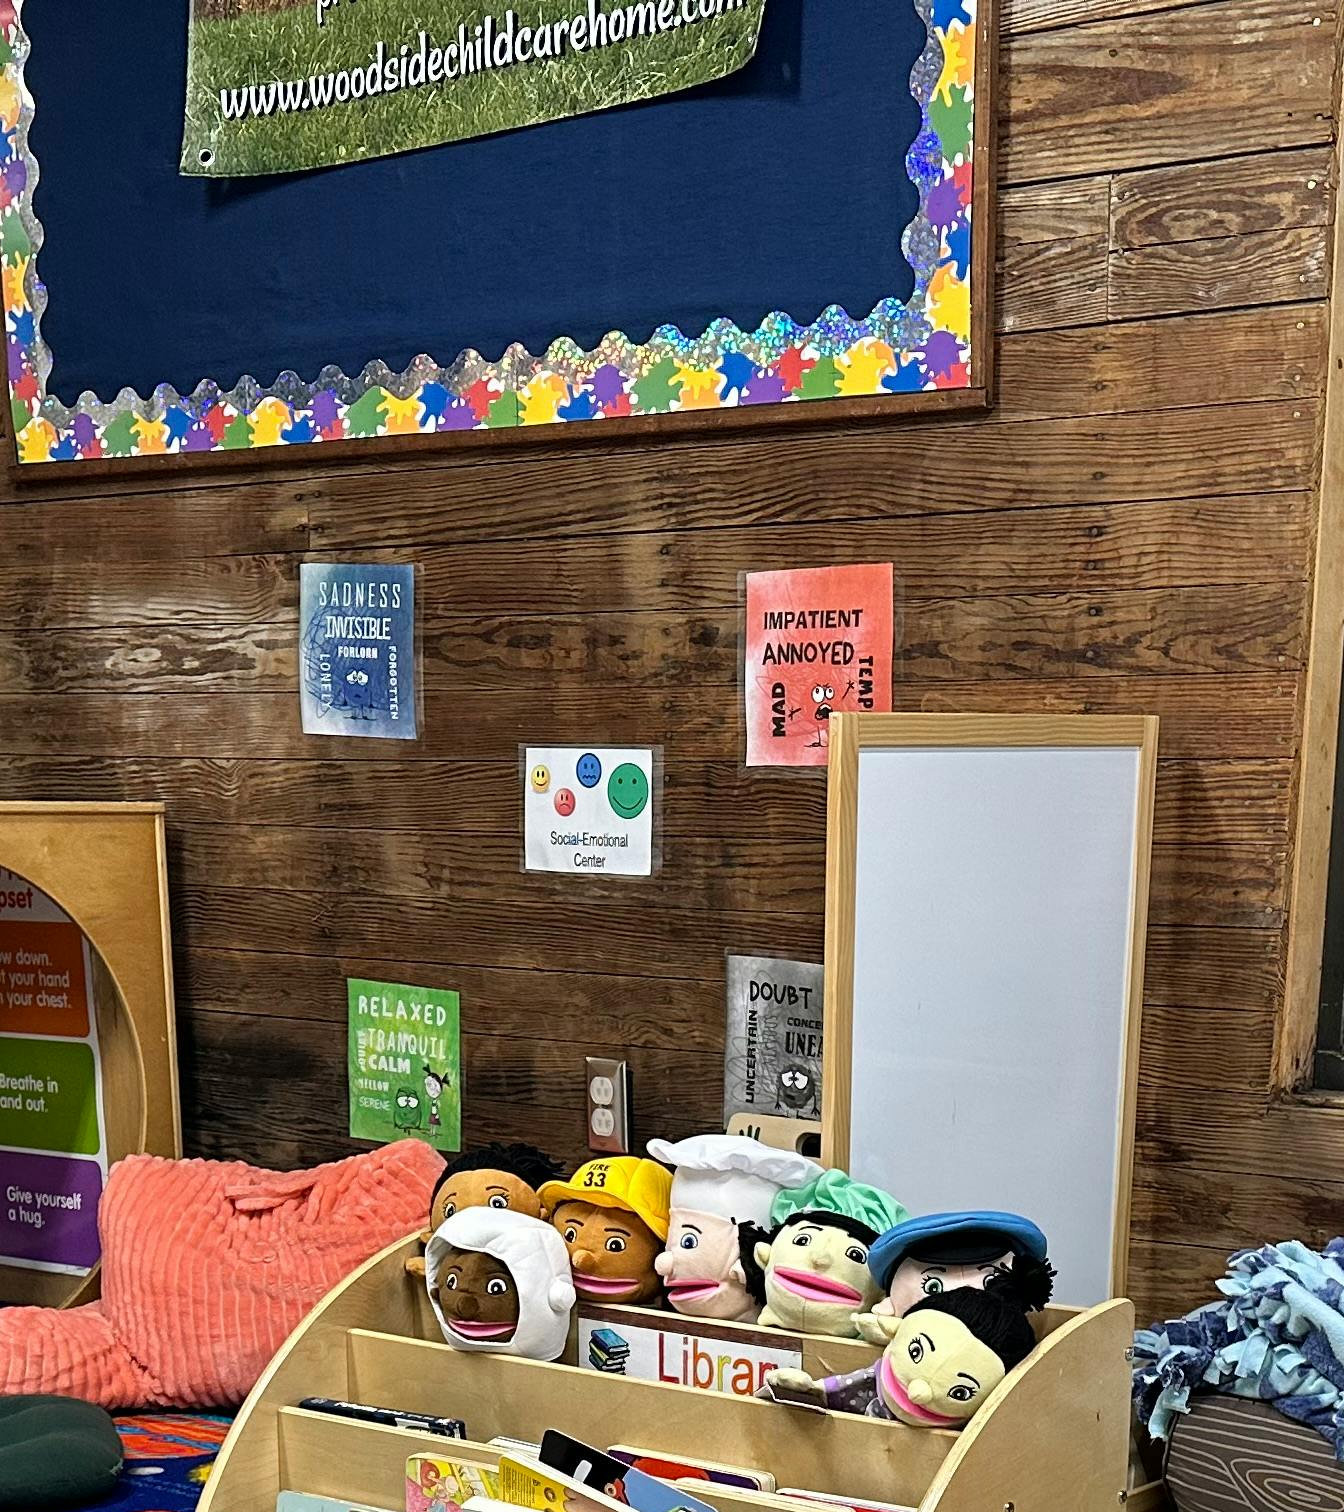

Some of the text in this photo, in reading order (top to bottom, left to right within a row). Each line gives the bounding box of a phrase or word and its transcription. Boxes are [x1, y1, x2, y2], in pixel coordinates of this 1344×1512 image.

[319, 581, 401, 609] SADNESS
[324, 615, 391, 640] INVISIBLE
[763, 608, 864, 630] IMPATIENT
[337, 646, 378, 659] FORLORN
[762, 640, 855, 666] ANNOYED
[319, 653, 333, 708] LONELY
[388, 645, 399, 720] FORGOTTEN
[857, 656, 873, 711] TEMP
[772, 682, 786, 738] MAD
[550, 830, 628, 848] Social-Emotional
[573, 852, 606, 868] Center
[16, 948, 53, 966] down.
[8, 971, 34, 988] your
[38, 969, 70, 988] hand
[7, 993, 33, 1009] your
[36, 991, 71, 1009] chest.
[749, 980, 813, 1009] DOUBT
[358, 995, 446, 1027] RELAXED
[787, 1017, 823, 1030] CONCE
[368, 1028, 447, 1060] TRANQUIL
[785, 1031, 823, 1058] UNEA
[368, 1054, 411, 1074] CALM
[745, 1010, 757, 1104] UNCERTAIN
[47, 1076, 58, 1093] in
[0, 1095, 48, 1112] and out.
[359, 1095, 391, 1111] SERENE
[584, 1171, 606, 1187] 33
[7, 1187, 81, 1211] Give yourself
[8, 1206, 45, 1228] a hug.
[658, 1332, 778, 1396] Librar
